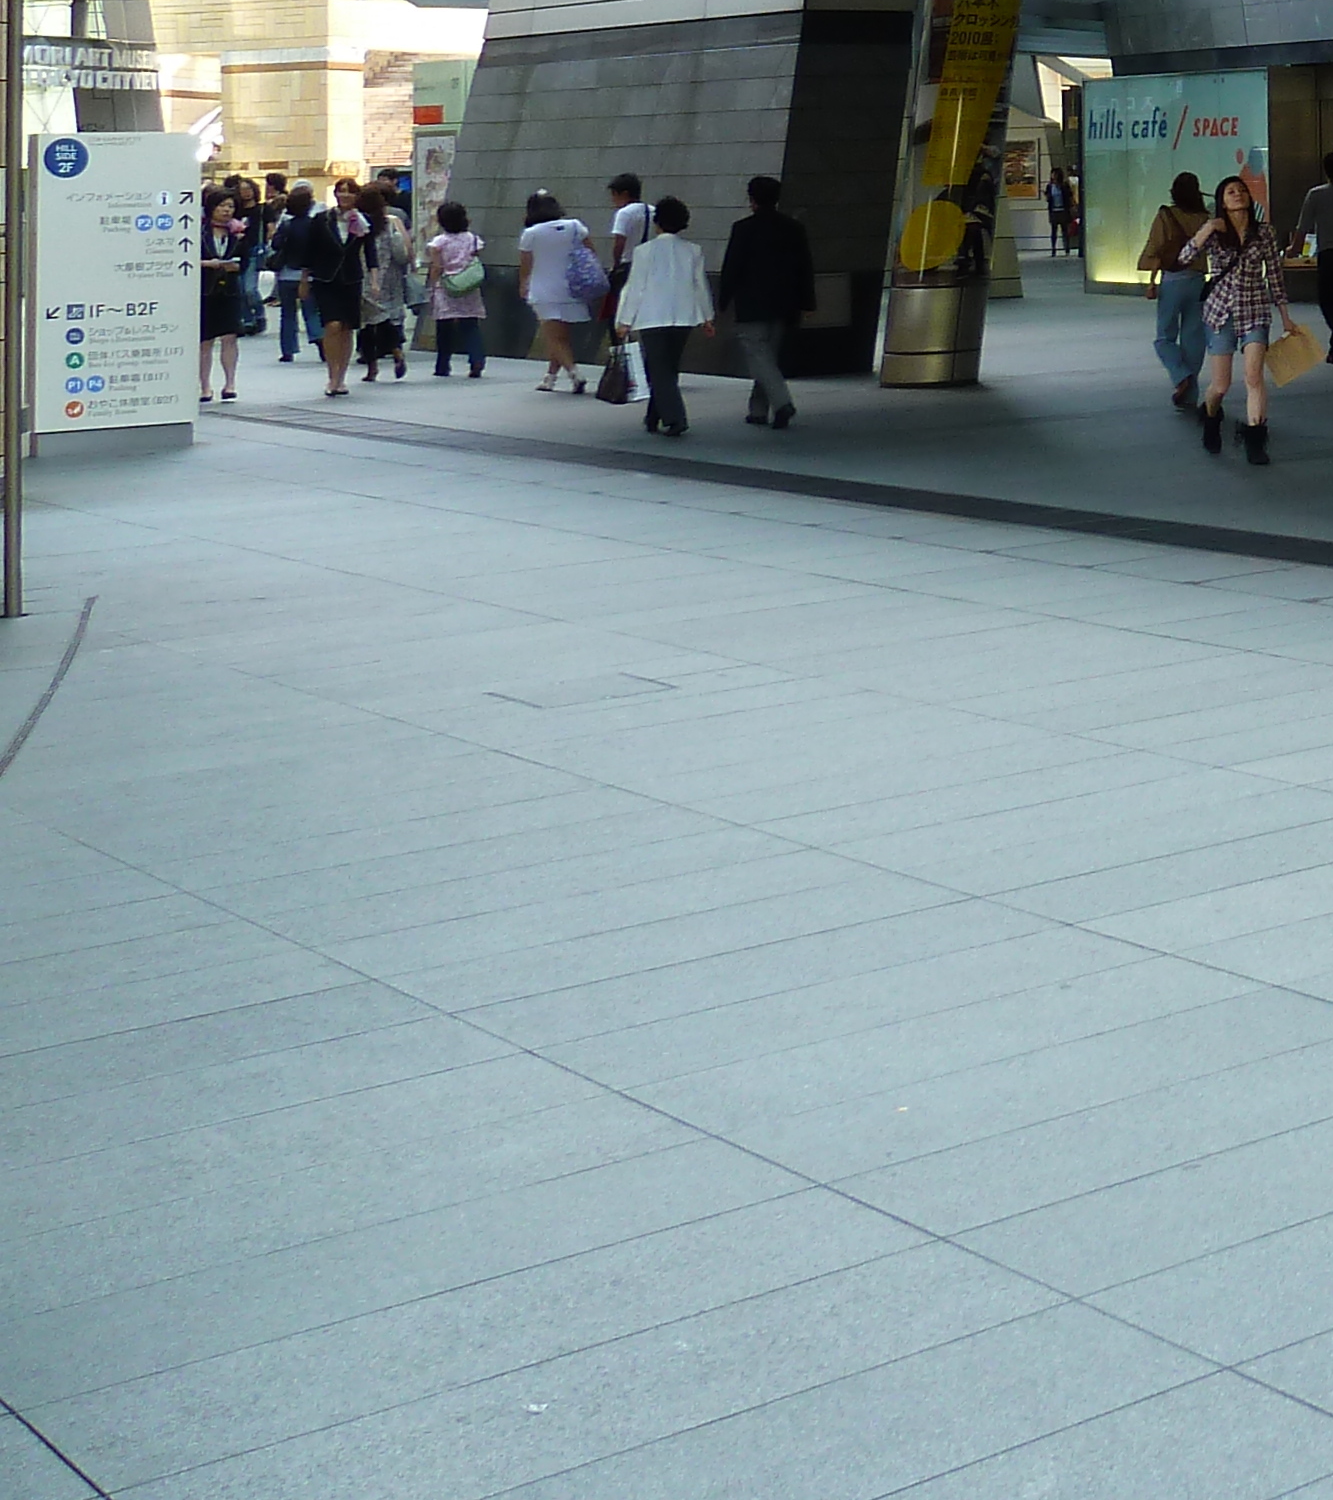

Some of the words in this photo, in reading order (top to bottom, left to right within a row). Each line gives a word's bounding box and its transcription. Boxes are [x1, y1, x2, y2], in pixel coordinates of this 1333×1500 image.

[1088, 106, 1123, 140] hills
[1131, 105, 1168, 139] café
[1193, 116, 1240, 138] SPACE
[55, 152, 77, 160] SIDE
[57, 162, 75, 173] 2F
[137, 219, 151, 228] P2
[69, 355, 80, 365] A
